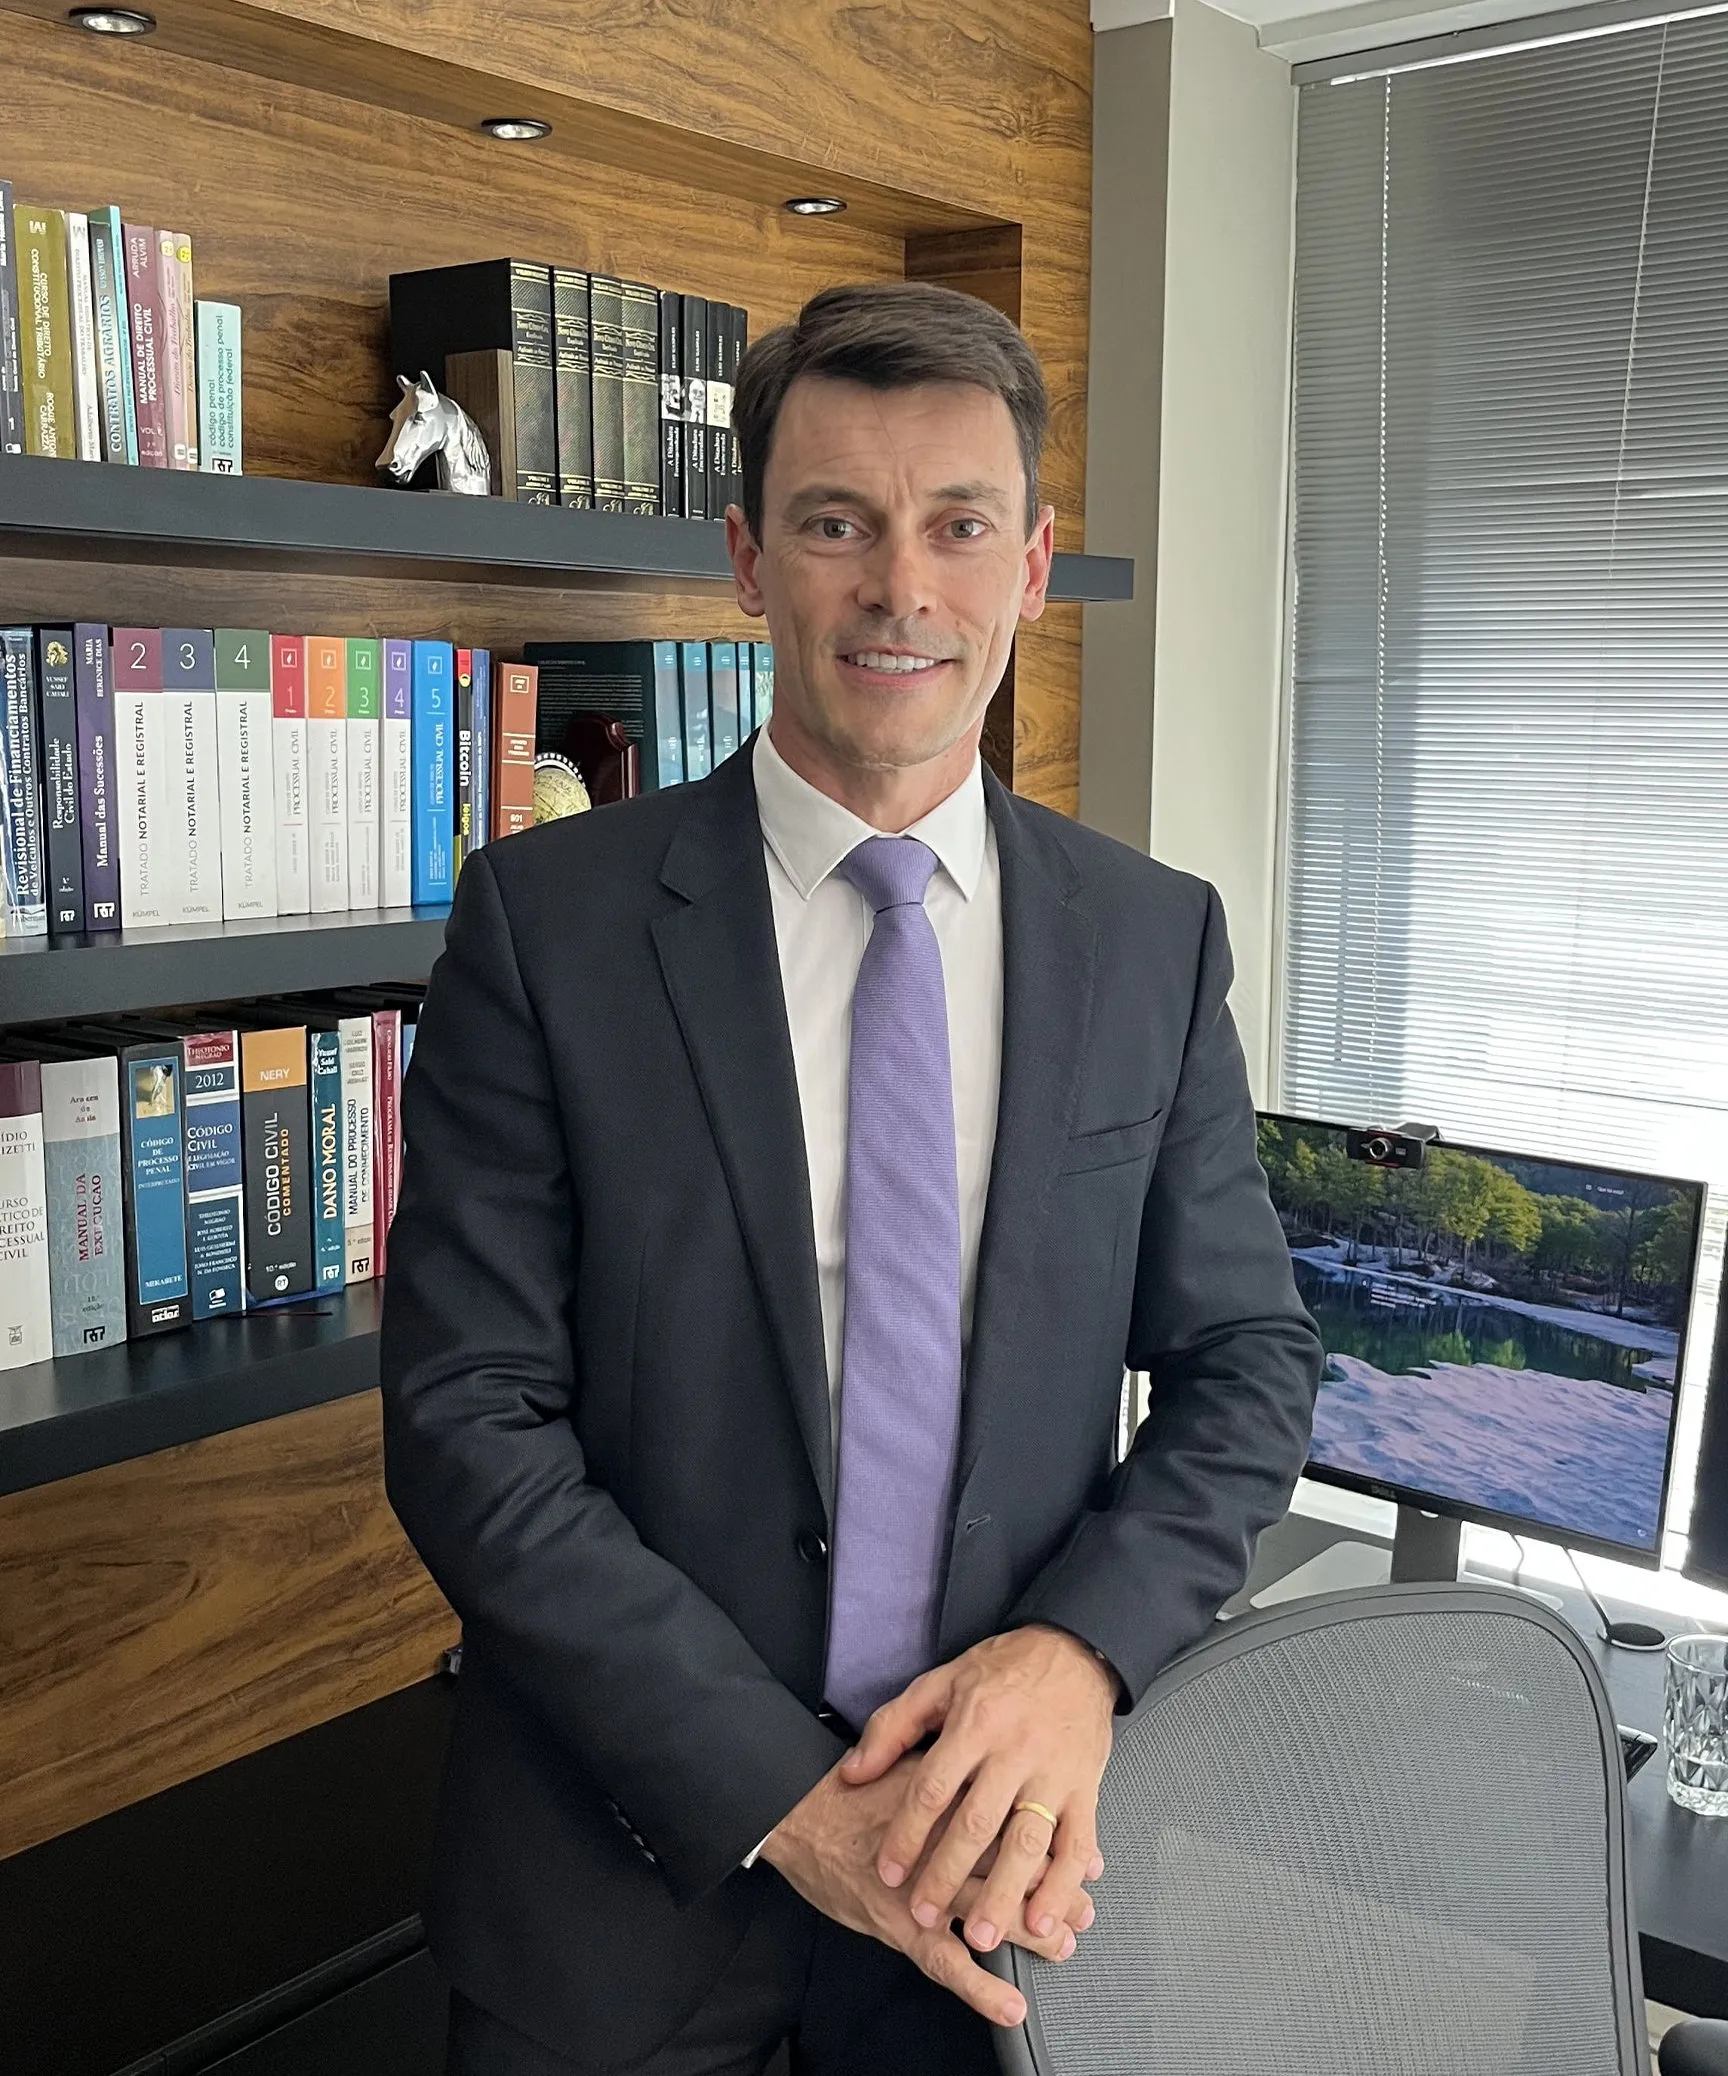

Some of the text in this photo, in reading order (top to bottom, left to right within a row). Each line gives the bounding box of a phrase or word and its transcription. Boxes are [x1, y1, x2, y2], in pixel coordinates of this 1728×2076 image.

[130, 237, 140, 278] ARRUDA
[138, 238, 148, 268] ALVIM
[30, 248, 46, 379] CONSTITUCIONAL TRIBUTÁRIO
[40, 272, 52, 357] CURSO DE DIREITO
[98, 295, 115, 367] AGRÁRIOS
[215, 315, 226, 346] penal
[133, 303, 149, 404] MANUAL DE DIREITO
[143, 307, 157, 401] PROCESSUAL CIVIL
[216, 347, 226, 394] processo
[40, 404, 50, 451] CARRAZZA
[46, 392, 55, 424] ROQUE
[104, 370, 121, 452] CONTRATOS
[207, 379, 218, 447] código penal
[225, 348, 236, 449] constituição federal
[216, 412, 227, 448] código
[666, 426, 674, 458] Ditadura
[85, 638, 94, 665] MARIA
[95, 638, 104, 697] BERENICE DIAS
[130, 642, 148, 670] 2
[179, 643, 196, 670] 3
[234, 644, 251, 670] 4
[4, 653, 23, 785] Financiamentos
[287, 685, 293, 707] 1
[325, 686, 336, 708] 2
[360, 686, 369, 708] 3
[394, 688, 405, 708] 4
[431, 688, 441, 709] 5
[134, 701, 145, 767] REGISTRAL
[183, 701, 194, 765] REGISTRAL
[239, 700, 249, 763] REGISTRAL
[459, 729, 472, 787] Bitcoin
[16, 653, 39, 896] de Veículos e Outros Contratos Bancários
[48, 737, 64, 829] Responsabilidade
[61, 743, 75, 824] Civil do Estado
[291, 728, 301, 815] PROCESSUAL CIVIL
[330, 728, 339, 814] PROCESSUAL CIVIL
[363, 728, 372, 813] PROCESSUAL CIVIL
[435, 722, 444, 805] PROCESSUAL CIVIL
[11, 788, 24, 809] de
[92, 735, 109, 867] Manual das Sucessões
[136, 779, 148, 840] NOTARIAL
[186, 777, 197, 837] NOTARIAL
[241, 775, 252, 834] NOTARIAL
[461, 803, 471, 836] leigos
[11, 811, 30, 896] Revisional
[138, 843, 149, 897] TRATADO
[188, 839, 199, 893] TRATADO
[243, 836, 253, 888] TRATADO
[188, 1044, 230, 1056] THEOTONIO
[260, 1068, 290, 1081] NERY
[195, 1072, 225, 1089] 2012
[140, 1136, 174, 1149] CÓDIGO
[152, 1148, 164, 1156] DE
[187, 1123, 233, 1139] CÓDIGO
[187, 1139, 218, 1152] CIVIL
[347, 1099, 358, 1215] MANUAL DO PROCESSO
[360, 1108, 370, 1186] CONHECIMENTO
[138, 1155, 178, 1168] PROCESSO
[145, 1165, 171, 1176] PENAL
[264, 1112, 281, 1236] CÓDIGO CIVIL
[280, 1128, 291, 1216] COMENTADO
[321, 1103, 337, 1219] DANO MORAL
[75, 1173, 89, 1261] MANUAL DA
